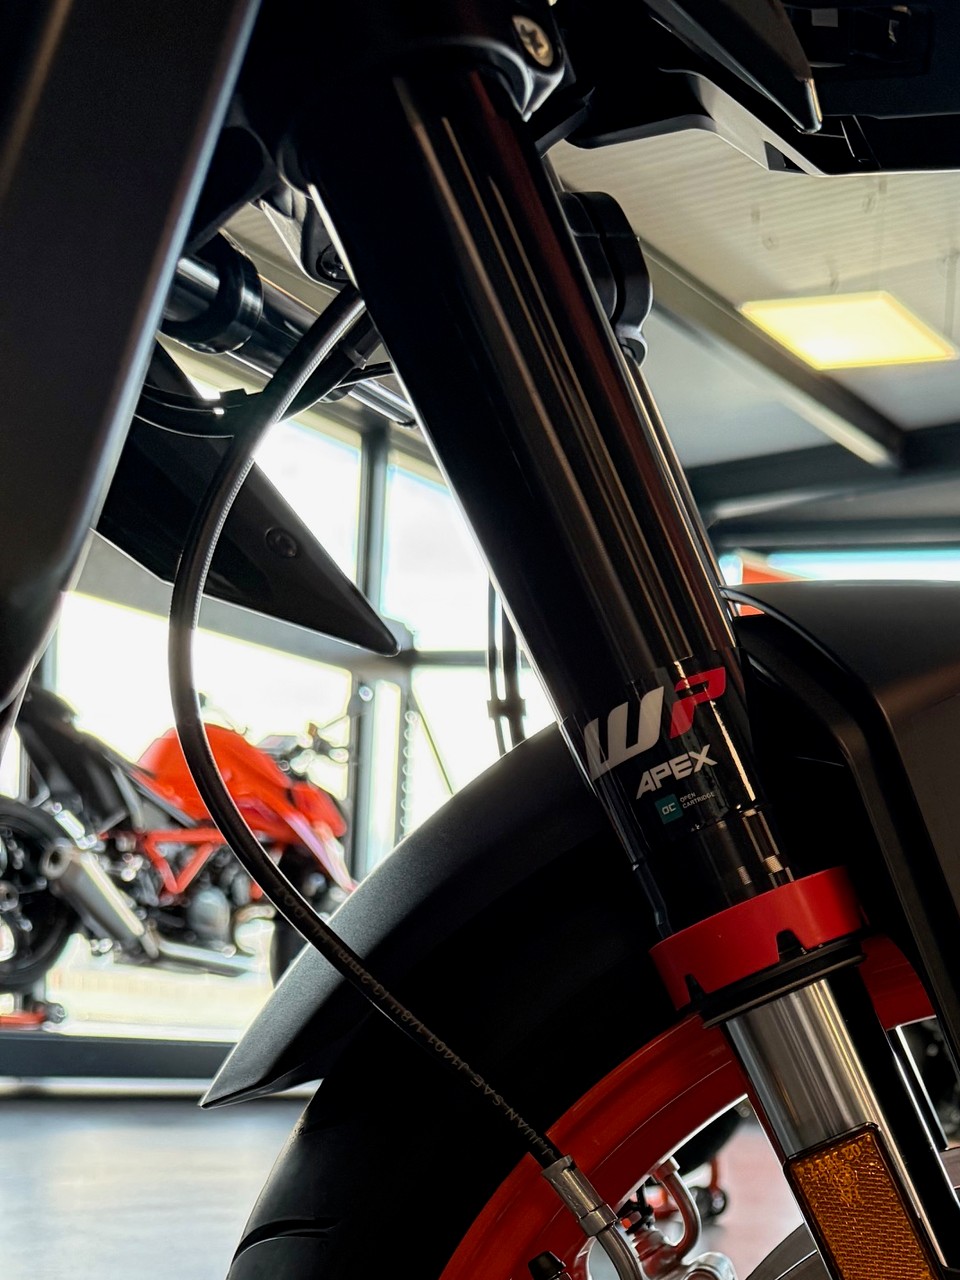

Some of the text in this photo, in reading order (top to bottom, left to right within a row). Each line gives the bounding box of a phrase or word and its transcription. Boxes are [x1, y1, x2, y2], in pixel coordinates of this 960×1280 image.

[583, 666, 727, 781] WP
[636, 744, 718, 800] APEX
[680, 792, 696, 803] OPEN
[682, 792, 716, 809] CARTRIDGE
[470, 1074, 506, 1107] SAE
